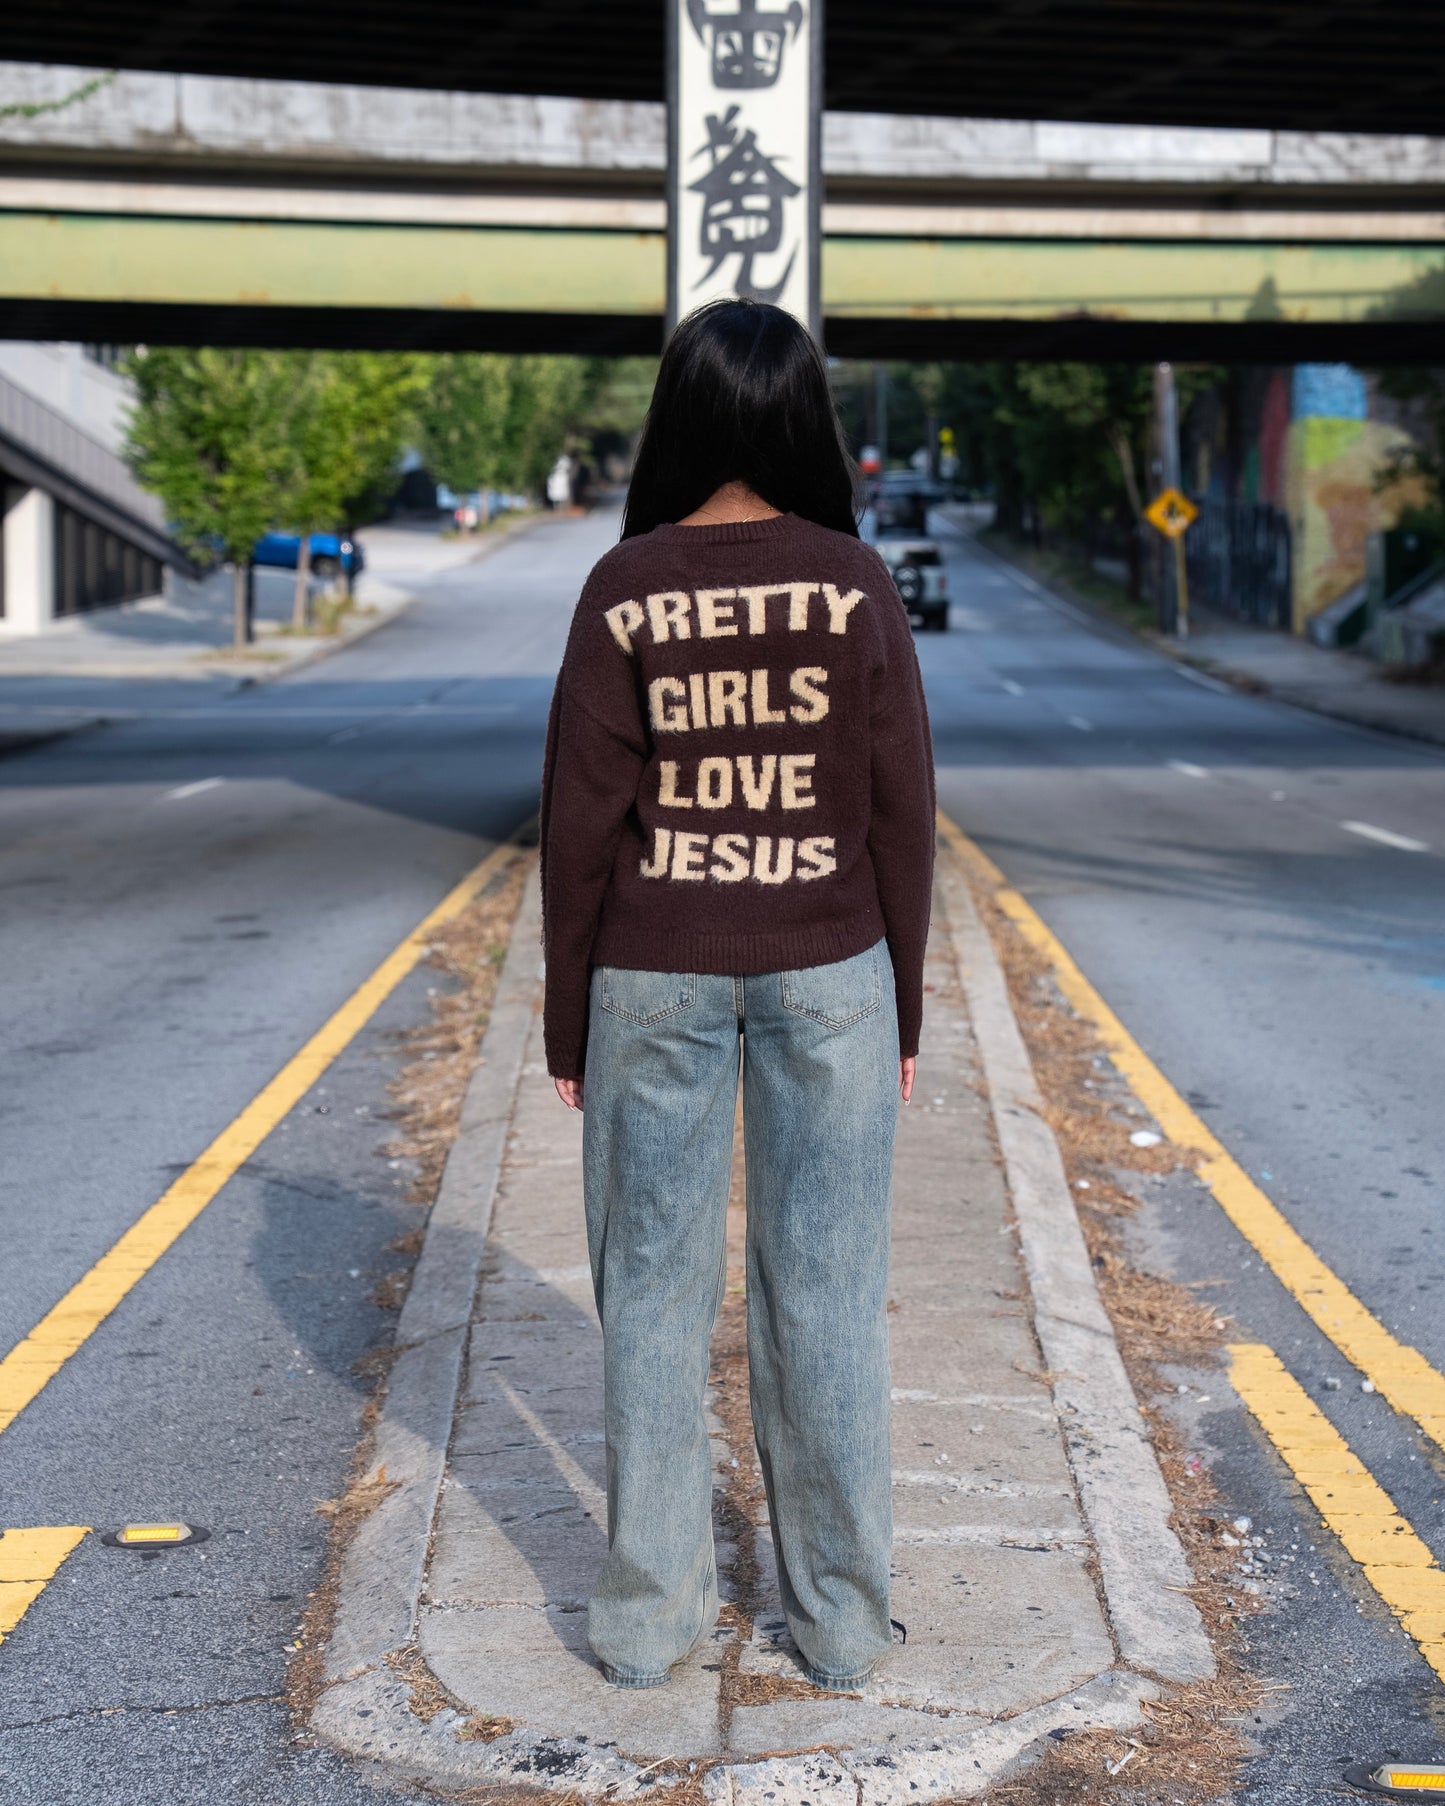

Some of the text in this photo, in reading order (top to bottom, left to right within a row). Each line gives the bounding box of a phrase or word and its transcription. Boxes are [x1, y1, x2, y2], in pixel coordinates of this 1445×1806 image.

[604, 582, 867, 655] PRETTY
[648, 666, 830, 733] GIRLS
[658, 753, 817, 811] LOVE
[640, 827, 837, 884] JESUS
